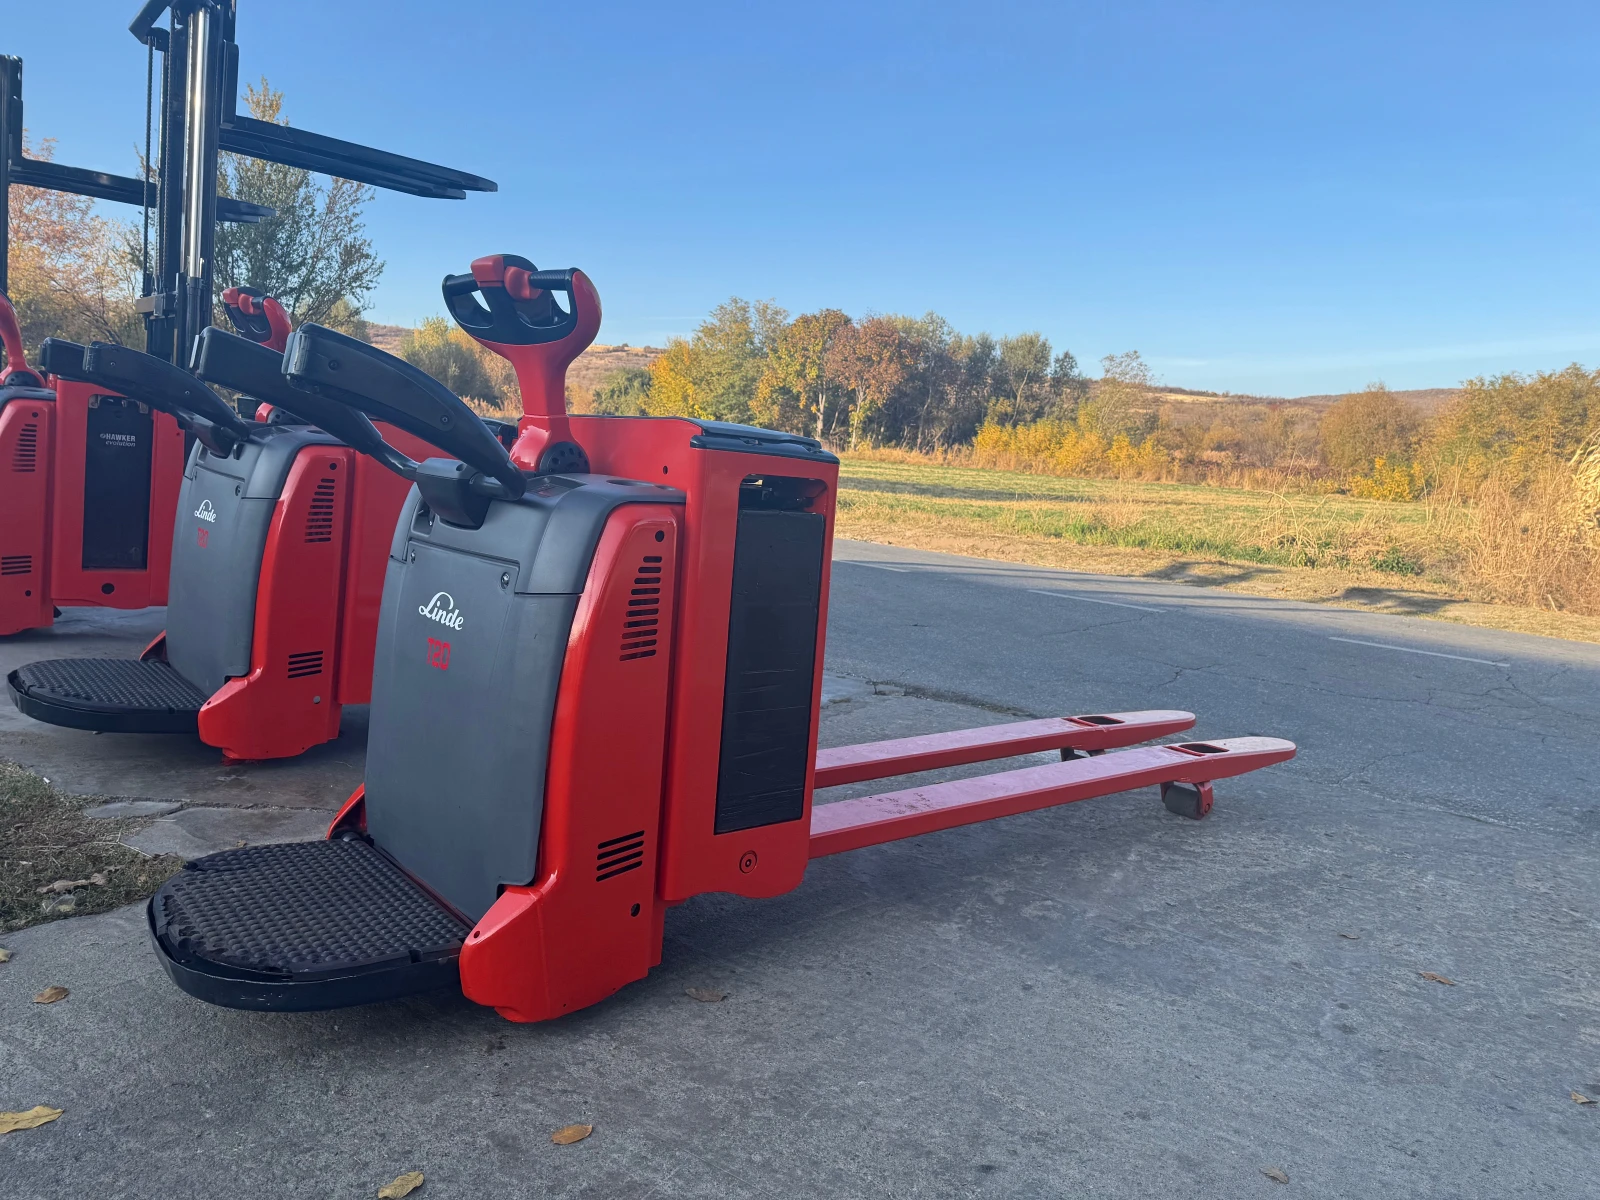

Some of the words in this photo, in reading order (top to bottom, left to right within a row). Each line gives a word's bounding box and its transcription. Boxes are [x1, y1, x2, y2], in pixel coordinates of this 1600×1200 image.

[105, 433, 136, 442] HAWKER
[194, 499, 216, 523] Linde
[418, 591, 464, 631] Linde
[427, 636, 451, 671] T20
